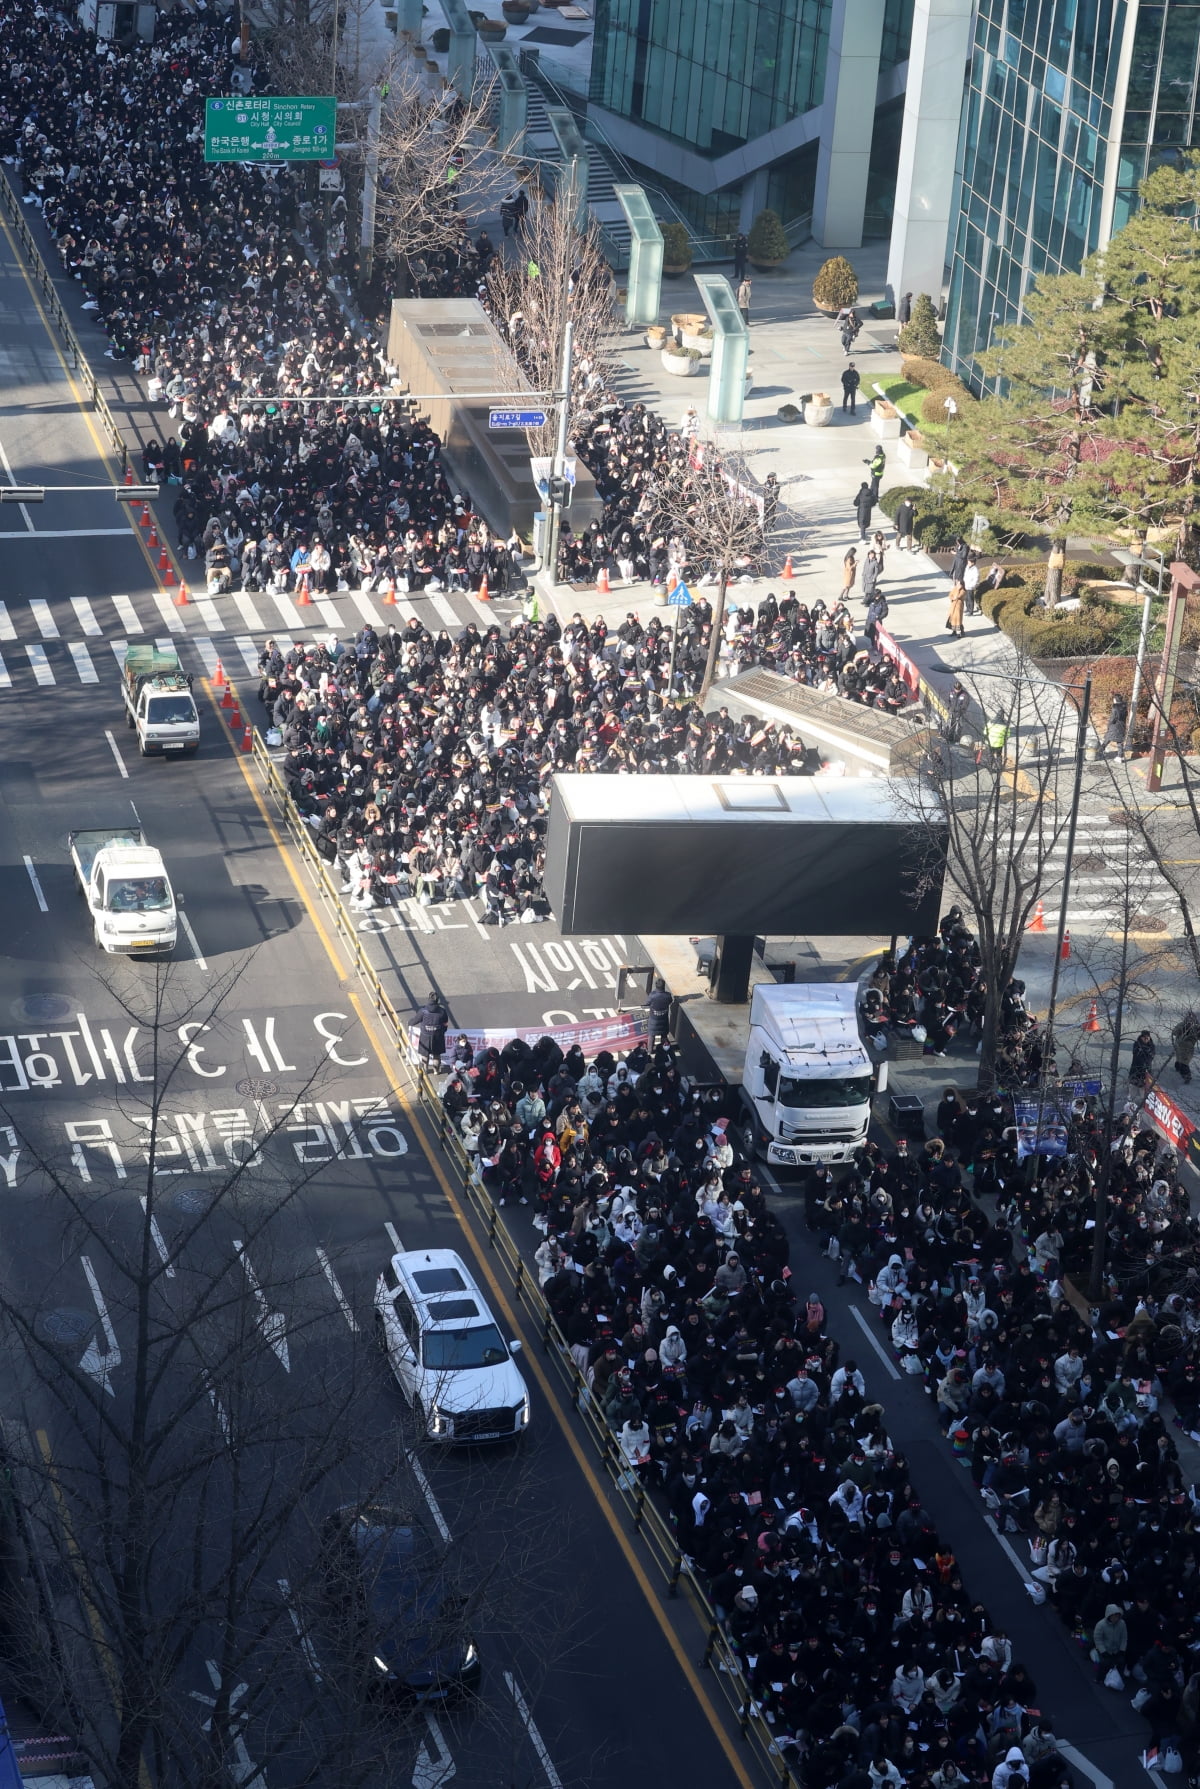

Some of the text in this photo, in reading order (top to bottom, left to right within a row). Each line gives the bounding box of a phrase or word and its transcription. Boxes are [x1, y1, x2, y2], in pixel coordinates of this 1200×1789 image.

[225, 99, 271, 111] 신촌로터리
[210, 135, 250, 147] 한국은행
[292, 135, 328, 145] 종로1가
[491, 413, 521, 421] 을지로7길
[279, 1096, 408, 1163] 을지로
[131, 1108, 265, 1176] 을지로
